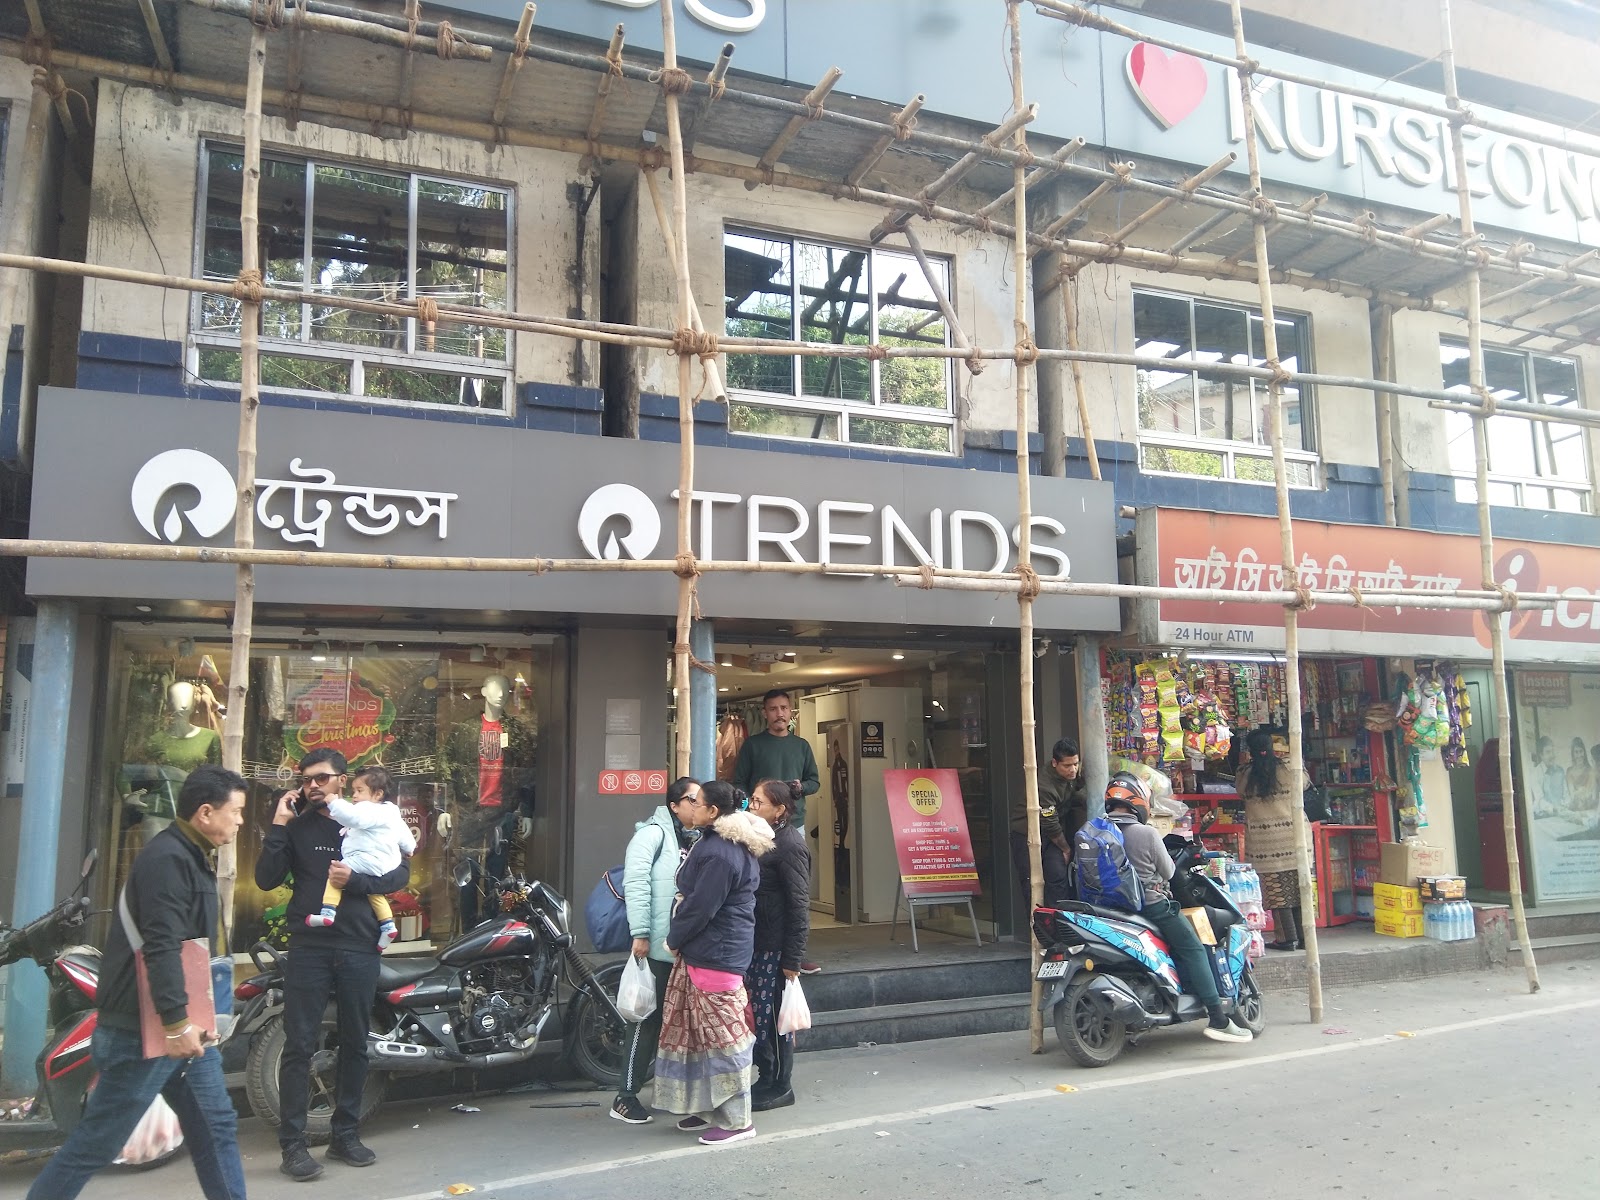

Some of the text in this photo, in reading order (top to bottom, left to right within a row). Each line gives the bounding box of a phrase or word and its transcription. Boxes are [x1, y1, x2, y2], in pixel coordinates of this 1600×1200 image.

[1226, 66, 1600, 223] KURSEON
[671, 488, 1071, 580] TRENDS
[1175, 627, 1254, 643] 24 Hour ATM
[1523, 673, 1565, 687] Instant
[315, 700, 378, 711] TRENDS
[297, 719, 380, 746] Christmas
[911, 790, 939, 798] SPECIAL
[916, 798, 937, 806] OFFER
[1122, 937, 1143, 952] LIMITED
